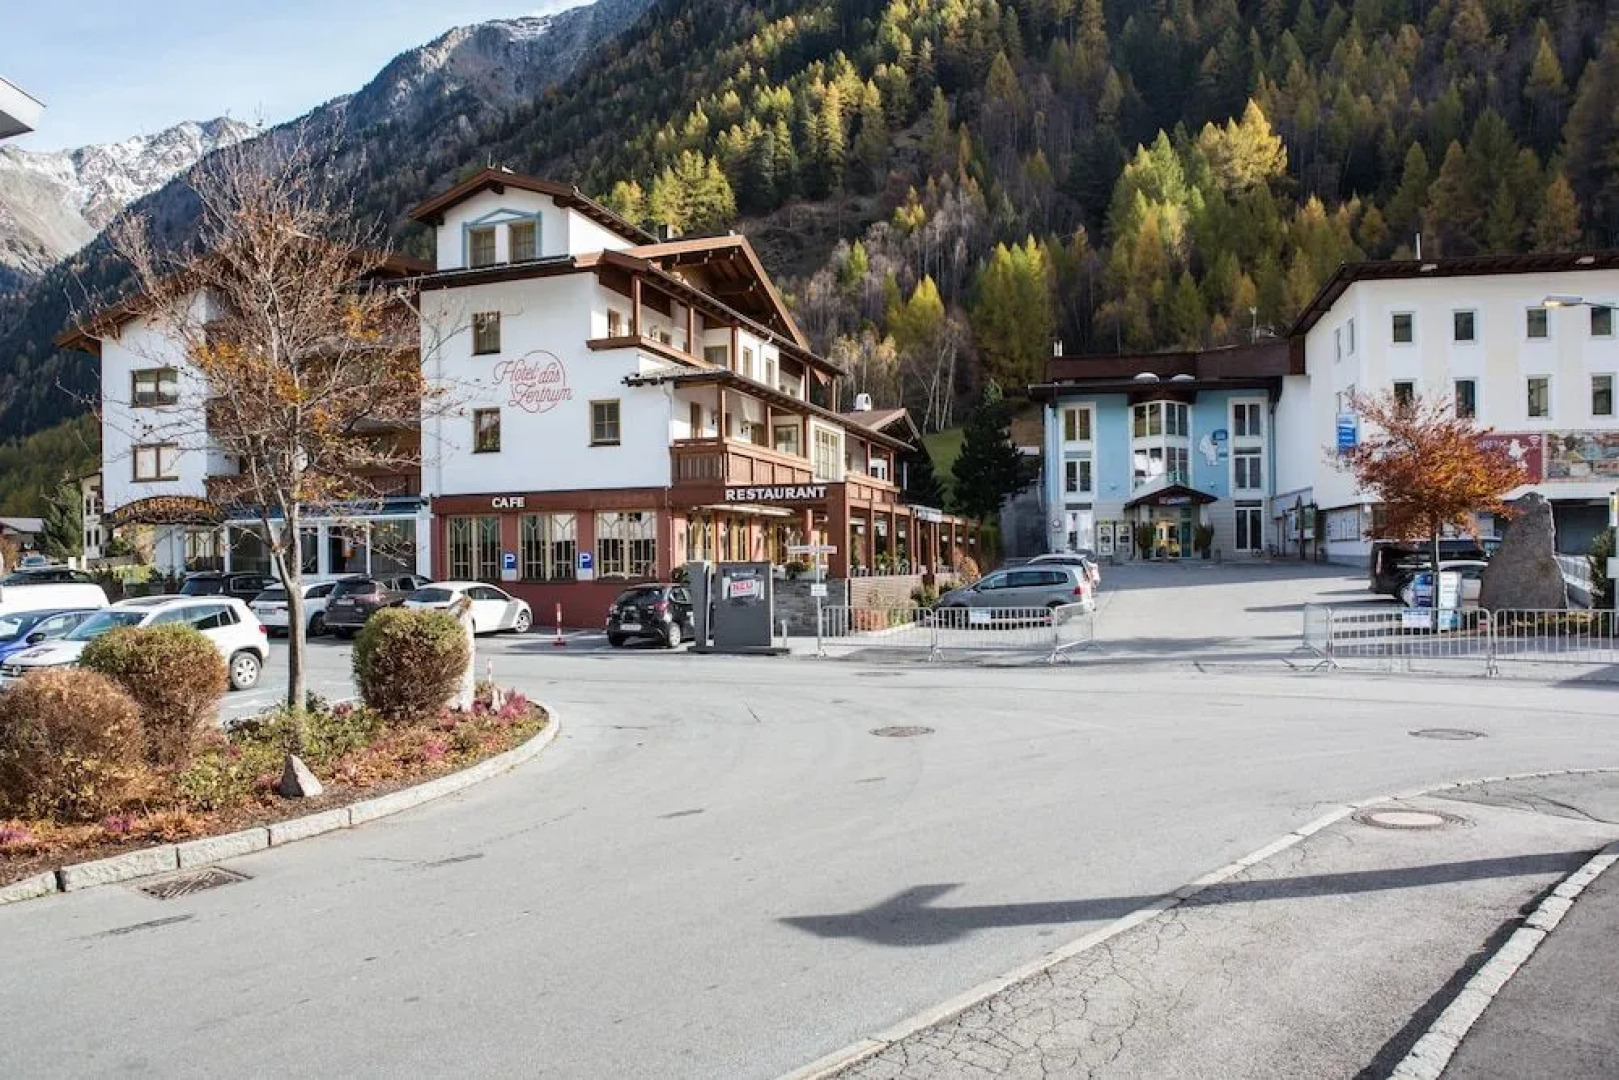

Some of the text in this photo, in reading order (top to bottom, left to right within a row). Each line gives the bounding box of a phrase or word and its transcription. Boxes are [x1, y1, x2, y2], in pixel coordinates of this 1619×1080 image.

[492, 359, 561, 385] Hotel das
[508, 381, 573, 407] Zentrum
[725, 486, 827, 501] RESTAURANT
[491, 496, 527, 508] CAFE
[504, 553, 516, 569] P
[579, 553, 592, 569] P
